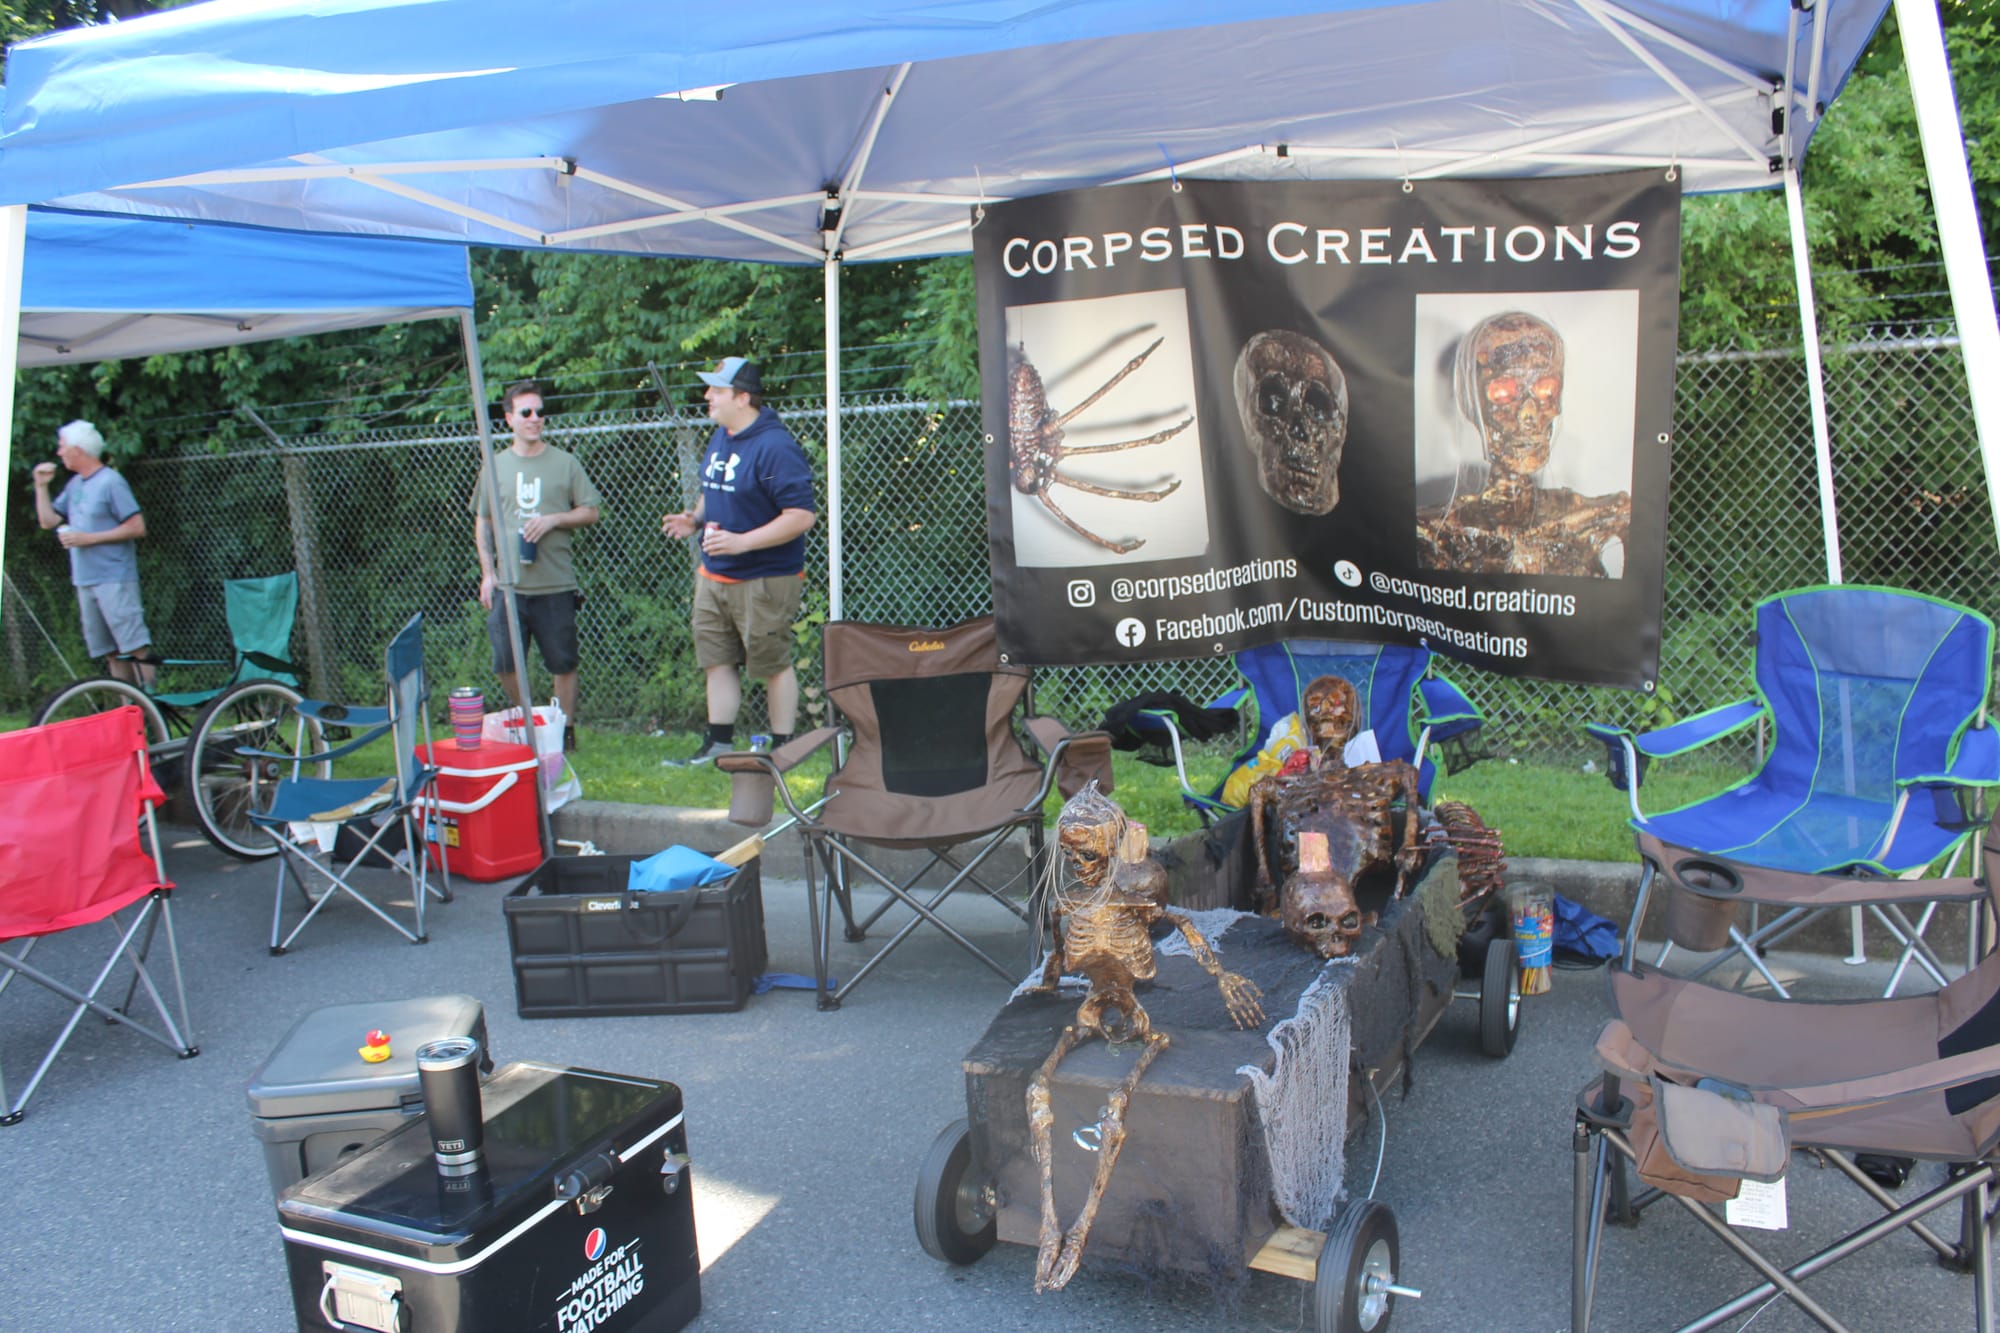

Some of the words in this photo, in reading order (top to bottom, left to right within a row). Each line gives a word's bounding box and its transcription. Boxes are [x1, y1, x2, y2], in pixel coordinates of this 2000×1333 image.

[1003, 223, 1245, 278] CORPSED
[1267, 221, 1641, 265] CREATIONS
[1111, 557, 1298, 603] @corpsedcreations
[1369, 571, 1577, 617] @corpsed.creations
[1155, 596, 1529, 658] Facebook.com/CustomCorpseCreations
[439, 1141, 463, 1150] YETI
[556, 1252, 644, 1332] FOOTBALL
[571, 1261, 604, 1296] MADE
[603, 1245, 626, 1272] FOR
